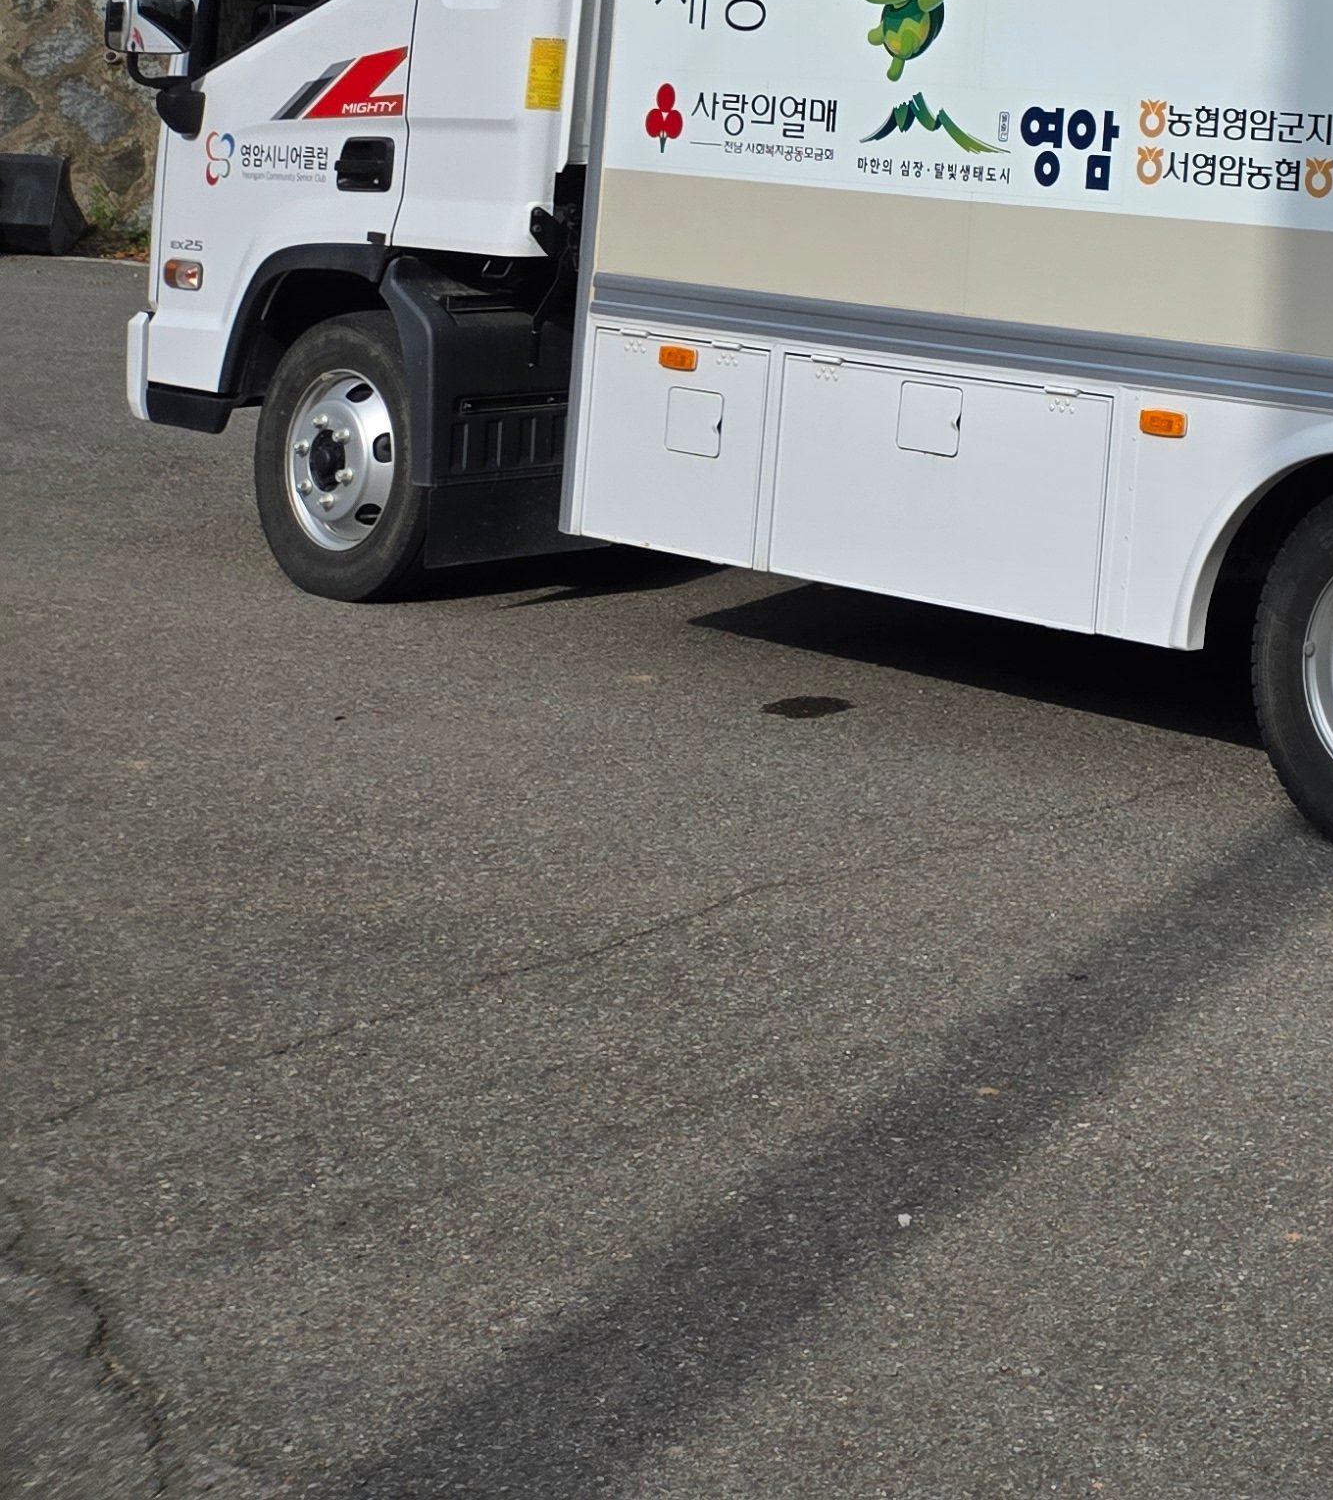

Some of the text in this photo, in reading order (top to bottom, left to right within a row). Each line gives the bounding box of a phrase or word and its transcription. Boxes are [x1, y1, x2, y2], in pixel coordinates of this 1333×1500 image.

[342, 101, 397, 114] MIGHTY
[690, 91, 837, 140] 사랑의열매
[240, 143, 329, 171] 영암시니어클럽
[857, 156, 892, 175] 마한의
[1020, 106, 1119, 191] 영암
[1163, 152, 1300, 192] 서영암농협
